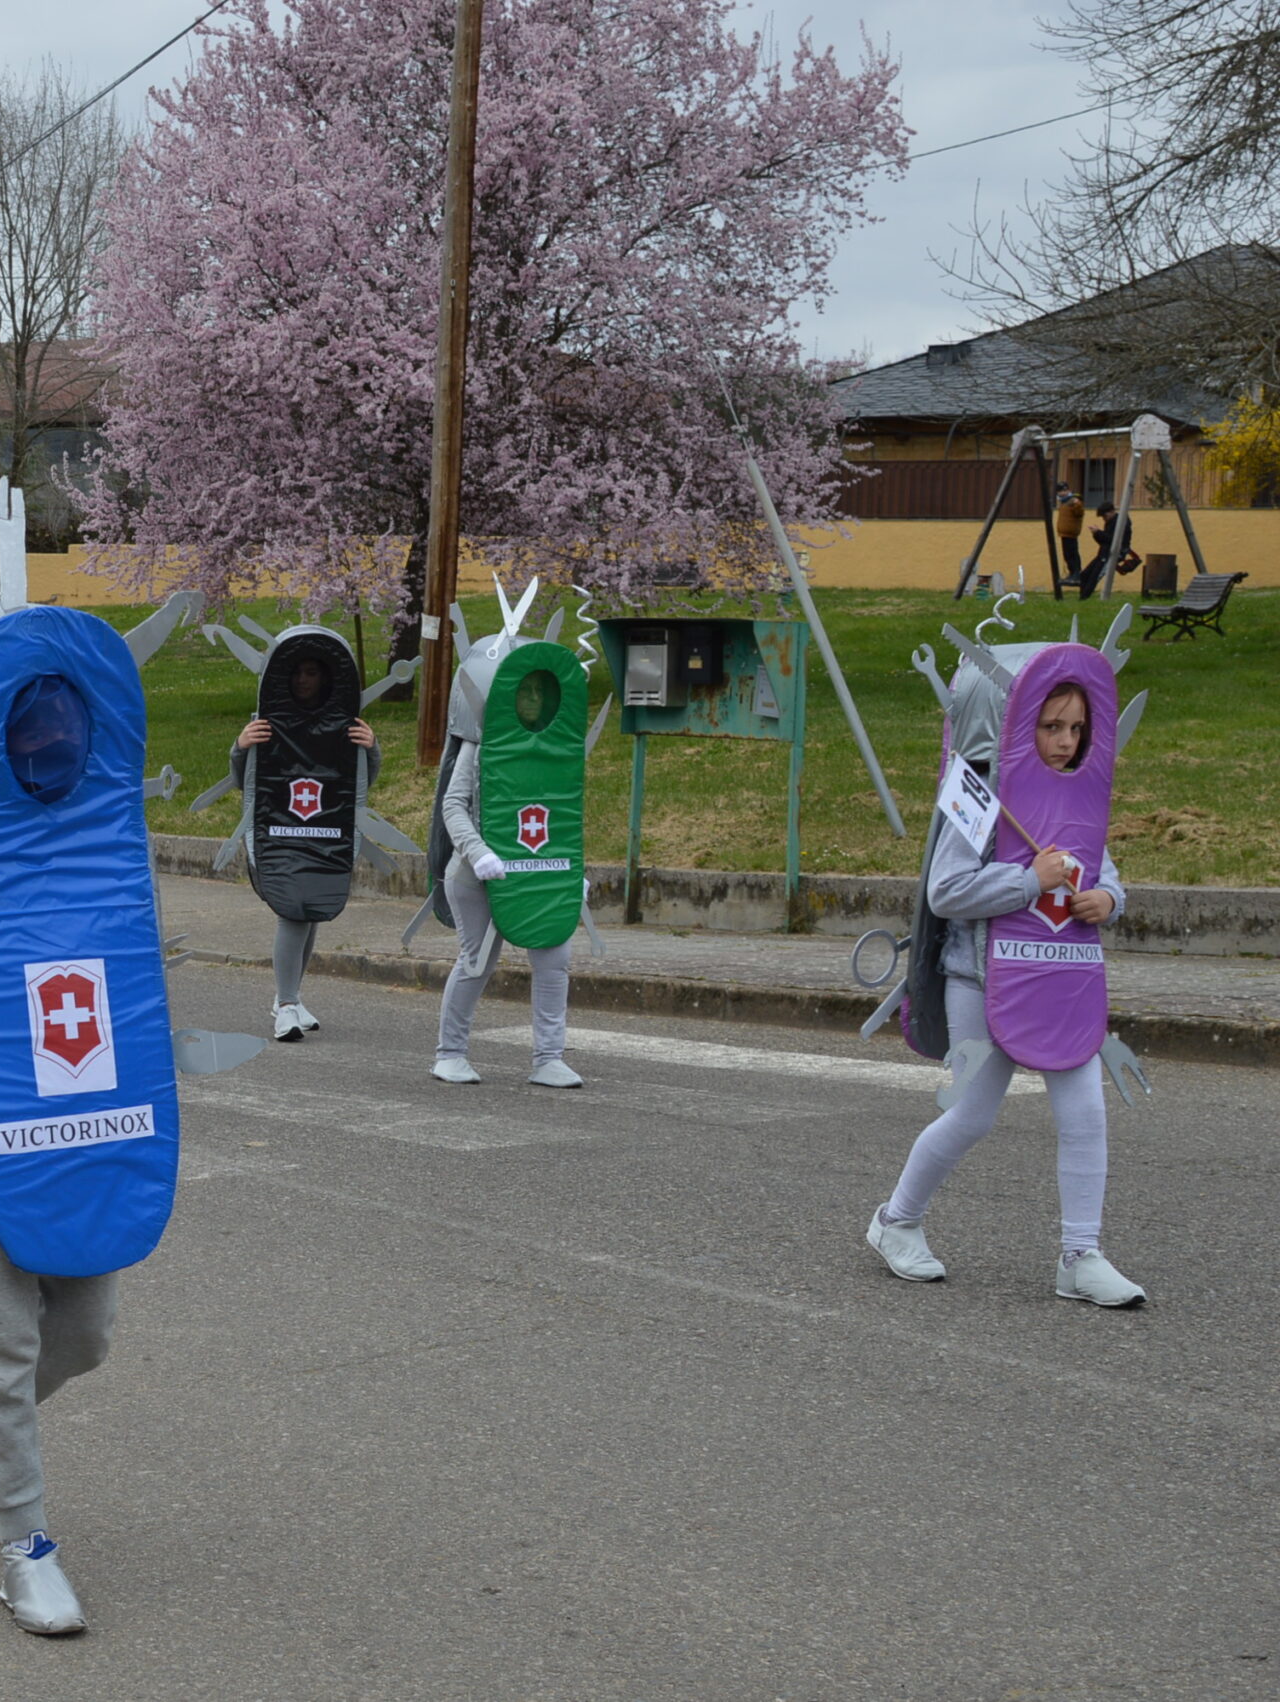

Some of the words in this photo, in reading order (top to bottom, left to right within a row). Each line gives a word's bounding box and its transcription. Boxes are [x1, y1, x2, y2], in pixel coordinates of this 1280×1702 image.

[960, 769, 991, 812] 19
[272, 826, 340, 838] VICTORINOX
[998, 942, 1101, 961] VICTORINOX
[0, 1112, 150, 1150] VICTORINOX
